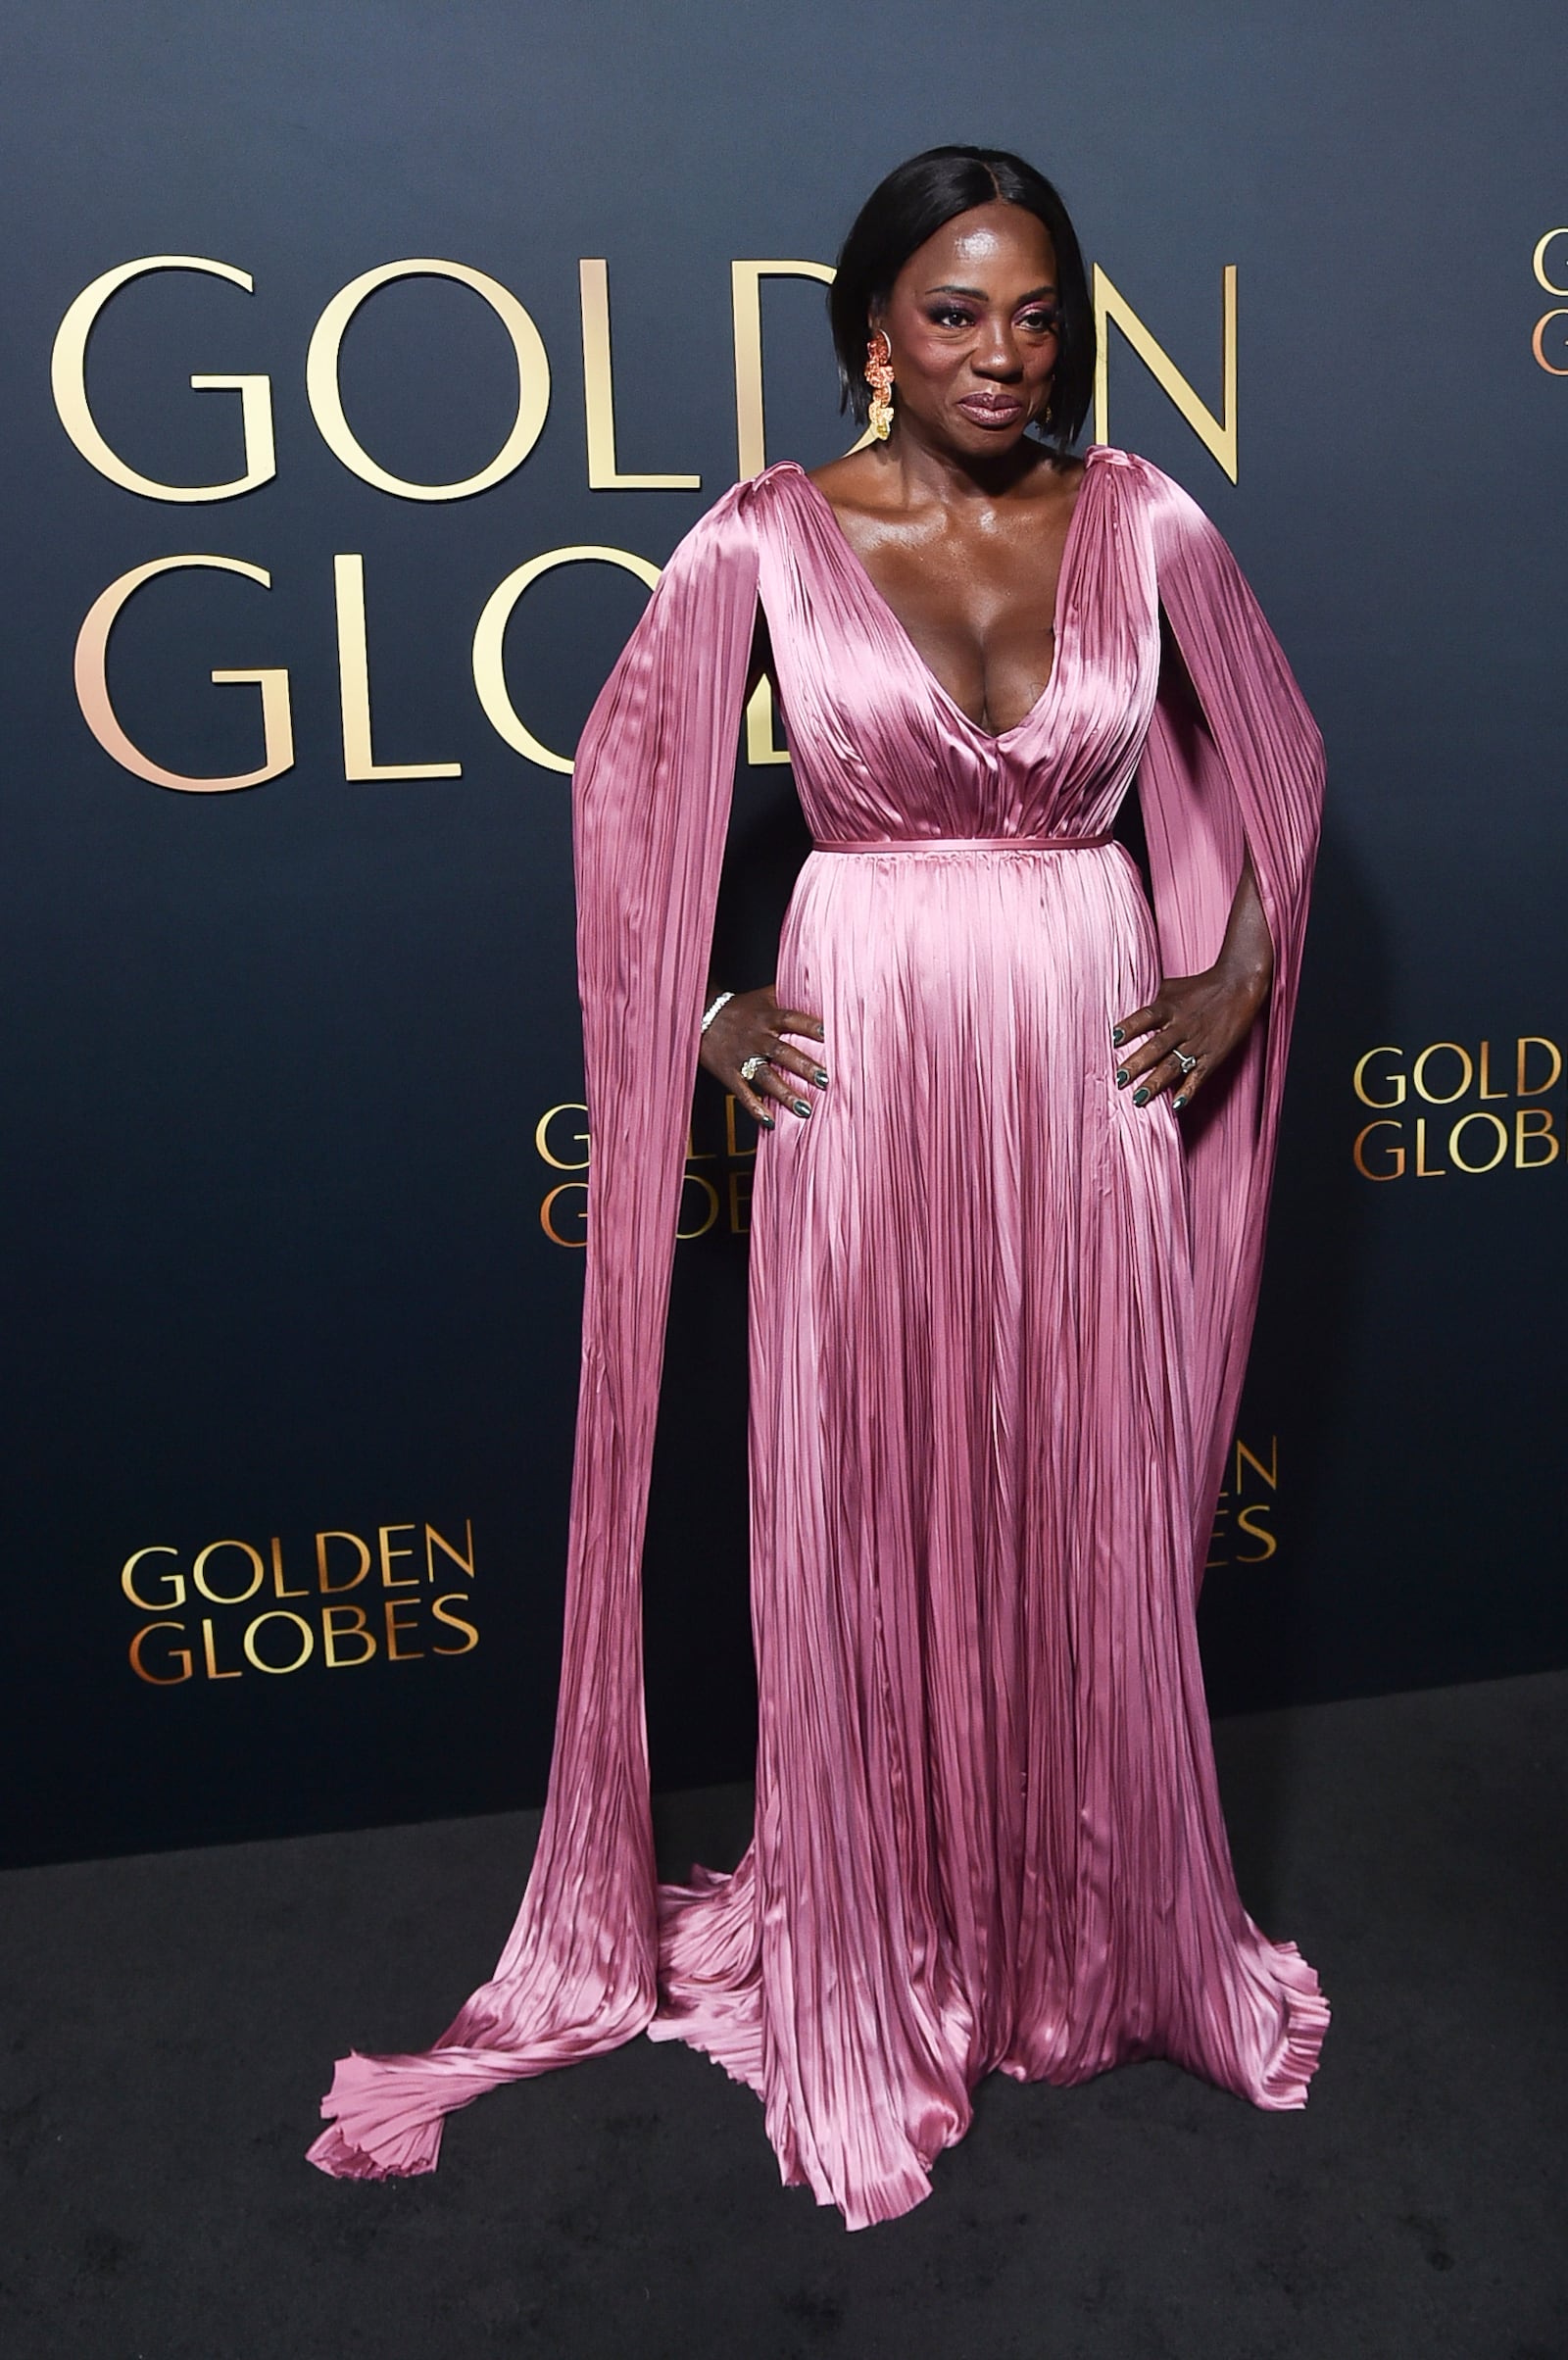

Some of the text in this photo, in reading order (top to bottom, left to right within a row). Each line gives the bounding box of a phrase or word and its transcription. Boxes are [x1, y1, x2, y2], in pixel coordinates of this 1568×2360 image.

[51, 255, 1238, 502] GOLDN
[1353, 1035, 1568, 1109] GOLD
[1353, 1108, 1568, 1182] GLOB
[121, 1519, 475, 1611] GOLDEN
[128, 1593, 480, 1686] GLOBES
